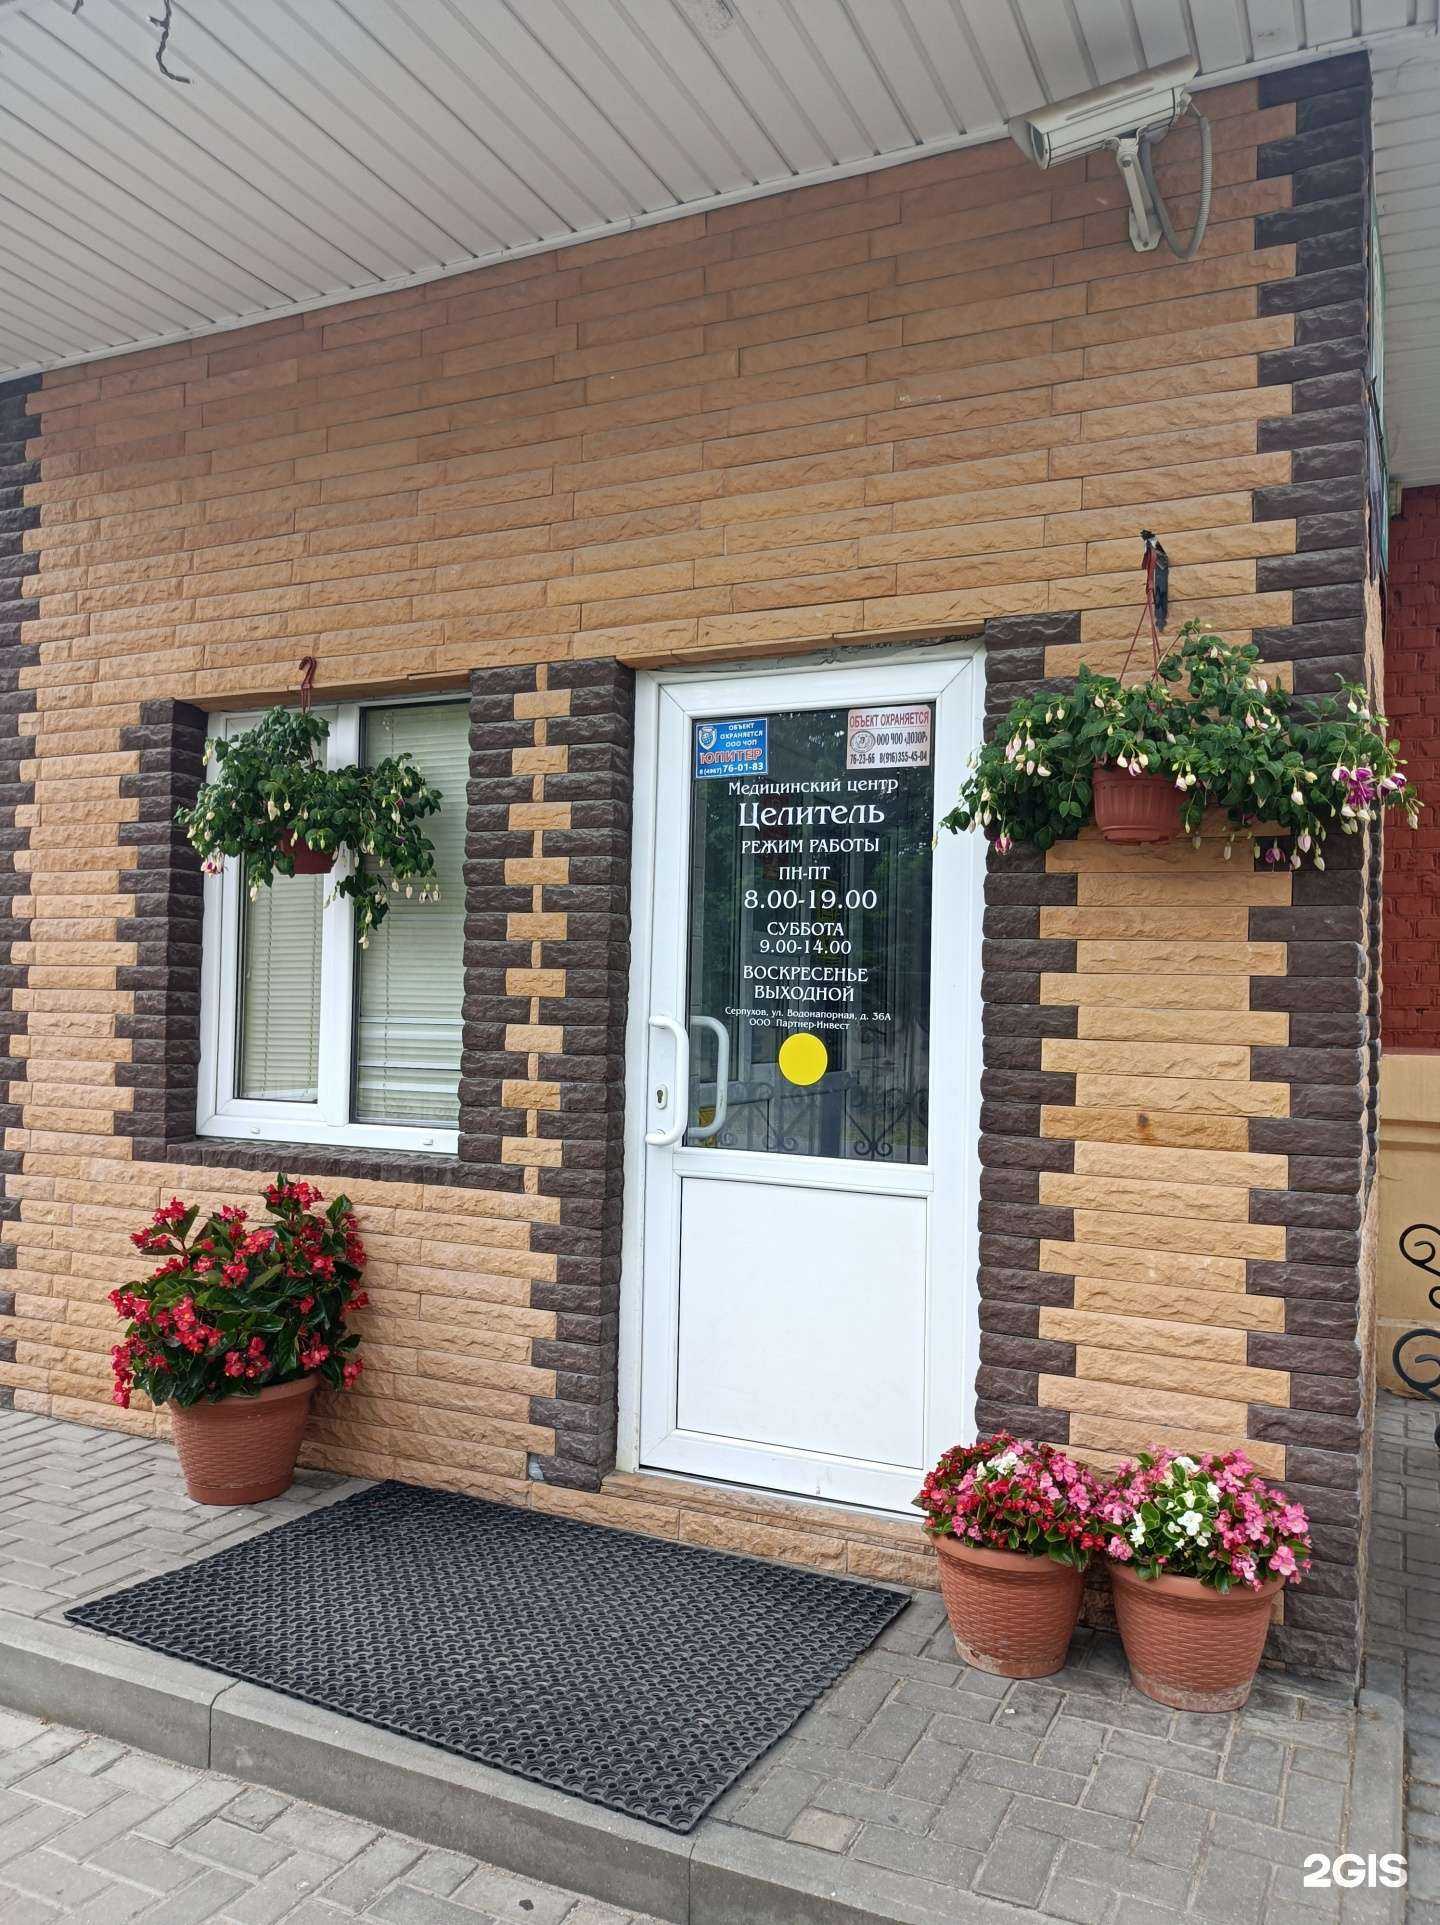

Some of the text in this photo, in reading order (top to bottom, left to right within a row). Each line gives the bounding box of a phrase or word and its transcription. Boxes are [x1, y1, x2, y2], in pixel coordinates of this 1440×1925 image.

[729, 723, 754, 731] ОБЪЕКТ
[850, 711, 929, 728] ОБЪЕКТ ОХРАНЯЕТСЯ
[720, 731, 763, 740] ОХРАНЯЕТСЯ
[726, 739, 757, 748] ООО ЧОП
[700, 748, 763, 765] ЮПИТЕР
[723, 762, 764, 773] 76-01-83
[729, 778, 898, 796] Медицинский центр
[738, 802, 885, 828] Целитель
[741, 838, 879, 854] РЕЖИМ РАБОТЫ
[779, 866, 831, 880] ПН-ПТ
[744, 889, 877, 910] 8.00-19.00
[767, 922, 844, 937] СУББОТА
[760, 939, 852, 955] 9.00-14.00
[743, 965, 869, 982] ВОСКРЕСЕНЬЕ
[754, 985, 854, 1002] ВЫХОДНОЙ
[787, 1008, 858, 1020] Водонапорная,
[749, 1018, 850, 1030] ООО Партнер-Инвест
